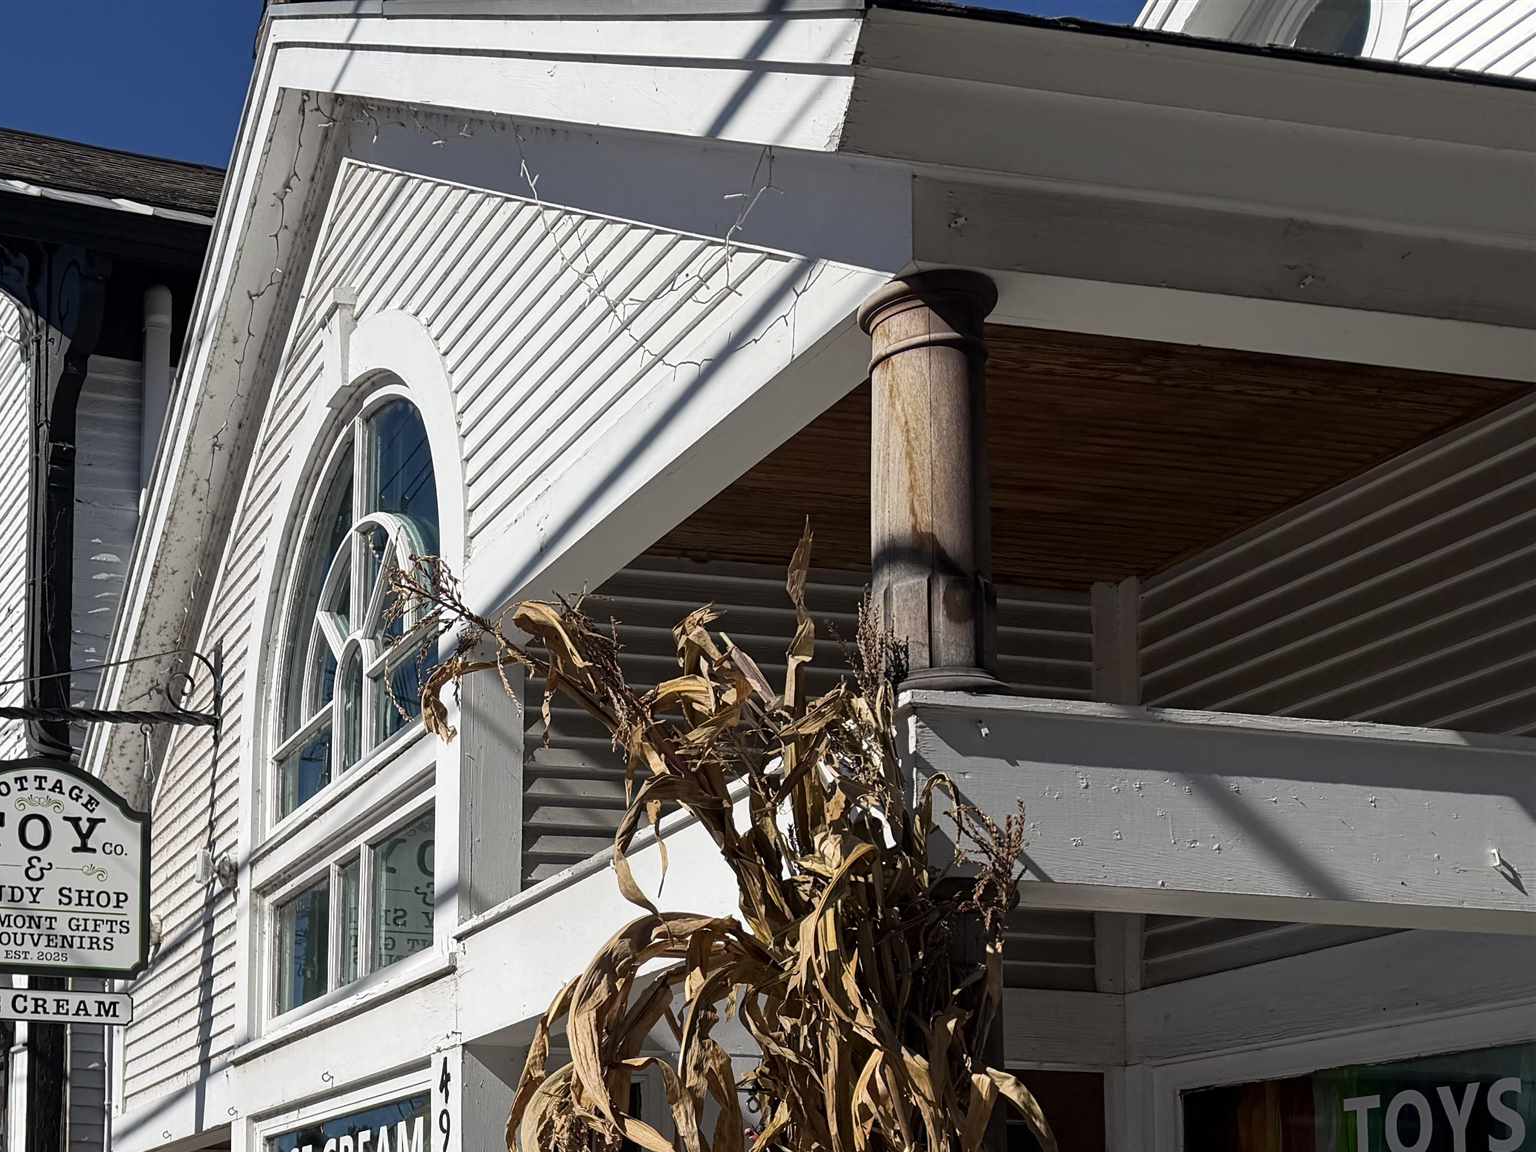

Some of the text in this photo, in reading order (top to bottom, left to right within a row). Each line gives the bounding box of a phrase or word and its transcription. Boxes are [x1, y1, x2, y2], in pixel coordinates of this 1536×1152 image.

[24, 855, 53, 882] &
[58, 887, 129, 909] SHOP
[68, 917, 130, 935] GIFTS
[3, 950, 69, 962] EST. 2025
[11, 993, 120, 1018] CREAM
